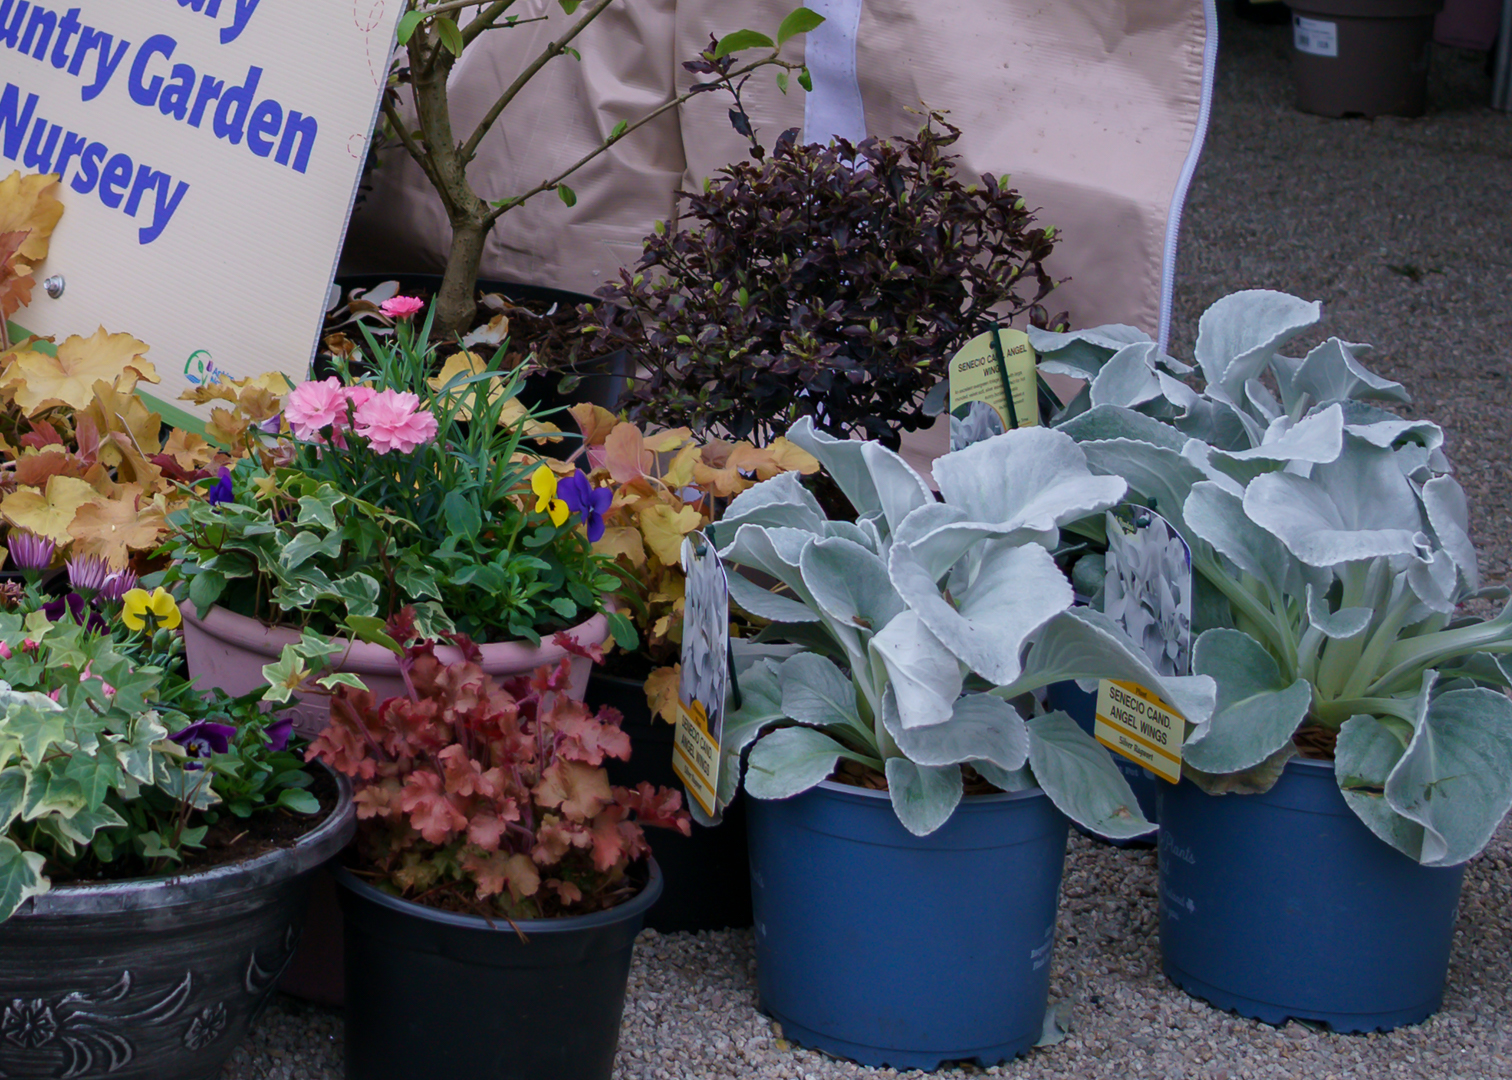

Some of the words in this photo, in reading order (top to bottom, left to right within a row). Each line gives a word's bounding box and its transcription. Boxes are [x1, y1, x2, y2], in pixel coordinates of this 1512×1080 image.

[127, 33, 318, 175] Garden
[958, 357, 986, 373] SENECIO
[1007, 344, 1027, 358] ANGEL
[983, 365, 1000, 377] WING
[1109, 686, 1145, 715] SENECIO
[1146, 707, 1172, 730] CAND.
[1110, 705, 1138, 730] ANGEL
[1140, 720, 1168, 745] WINGS
[681, 715, 700, 744] SENECIO
[1119, 736, 1133, 750] Silver
[681, 734, 695, 759] ANGEL
[696, 751, 710, 776] WINGS
